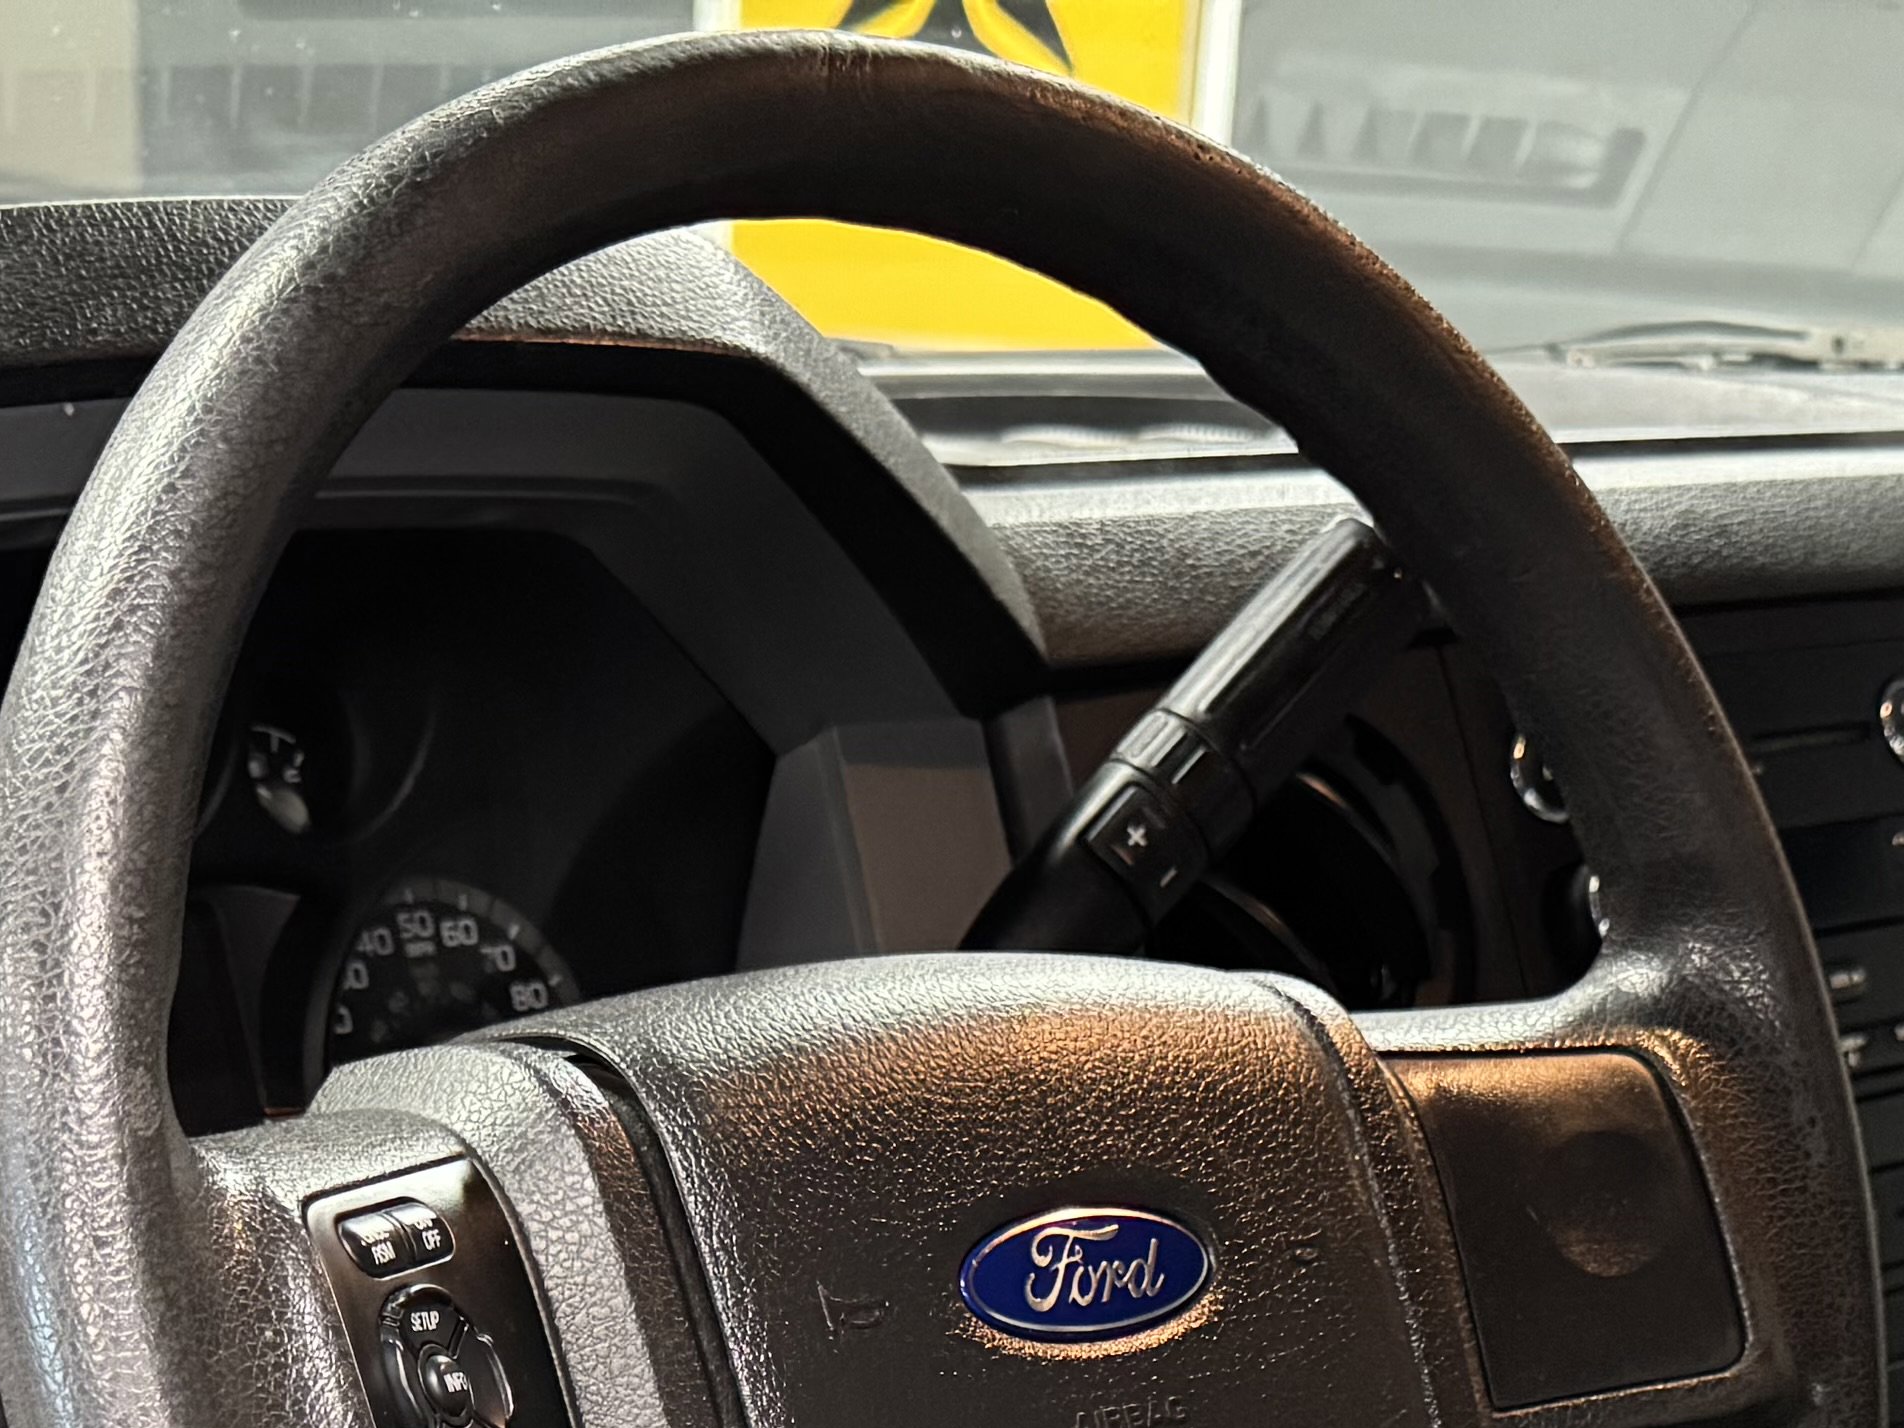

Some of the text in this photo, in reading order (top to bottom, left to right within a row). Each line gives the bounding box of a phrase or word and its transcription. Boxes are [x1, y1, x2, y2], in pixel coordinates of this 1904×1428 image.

[398, 910, 435, 939] 50
[441, 917, 478, 947] 60
[357, 926, 395, 956] 40
[480, 943, 516, 973] 70
[343, 959, 369, 990] 0
[510, 981, 548, 1012] 80
[421, 1229, 441, 1251] OFF
[1023, 1224, 1165, 1312] Ford
[410, 1310, 440, 1332] SETUP
[443, 1371, 469, 1393] INFO
